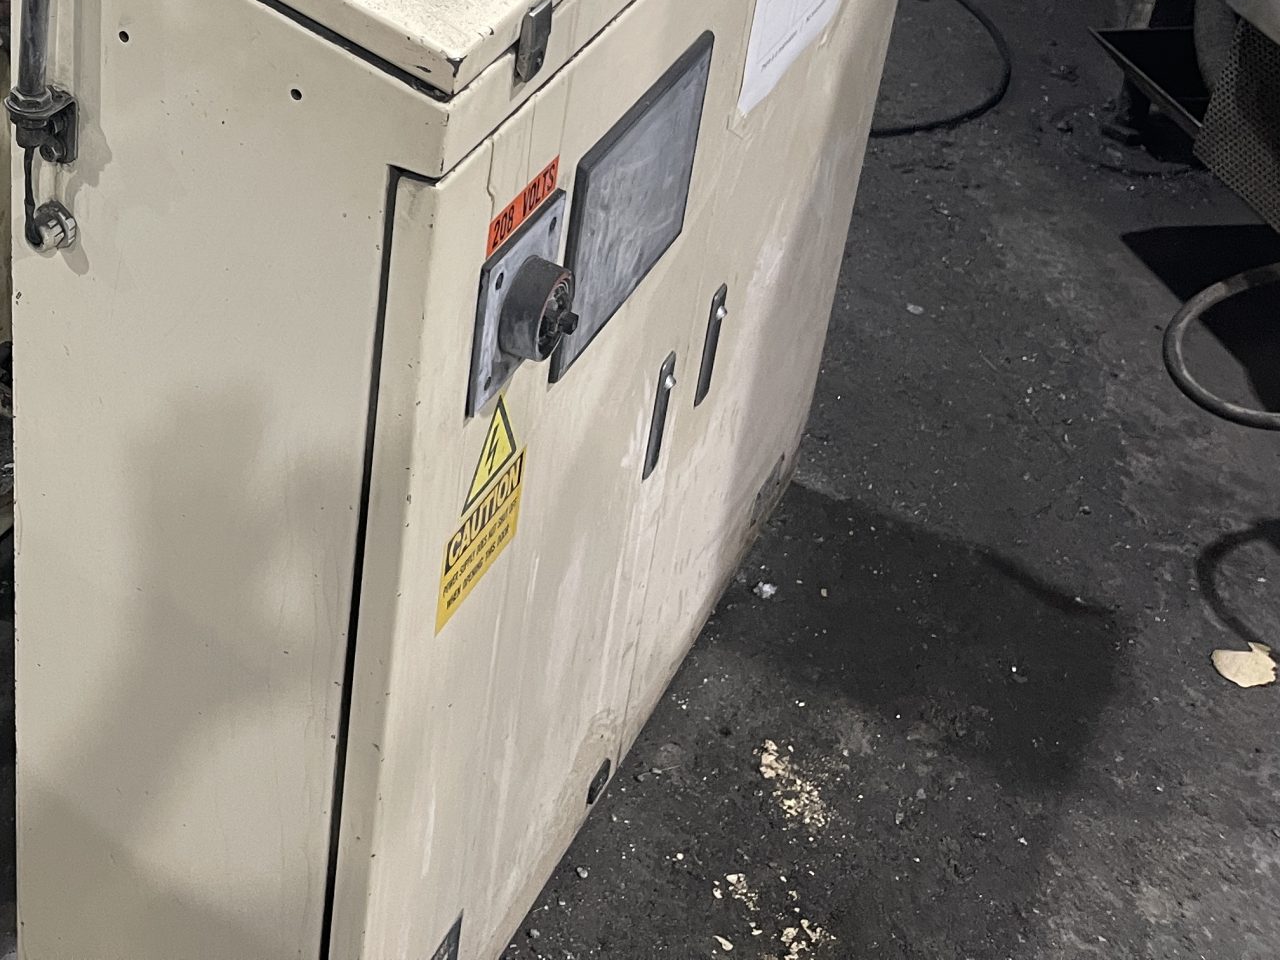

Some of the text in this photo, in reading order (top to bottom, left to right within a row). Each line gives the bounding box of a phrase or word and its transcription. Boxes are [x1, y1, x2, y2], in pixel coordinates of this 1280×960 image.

[492, 163, 555, 249] 208 VOLTS
[448, 459, 520, 566] CAUTION
